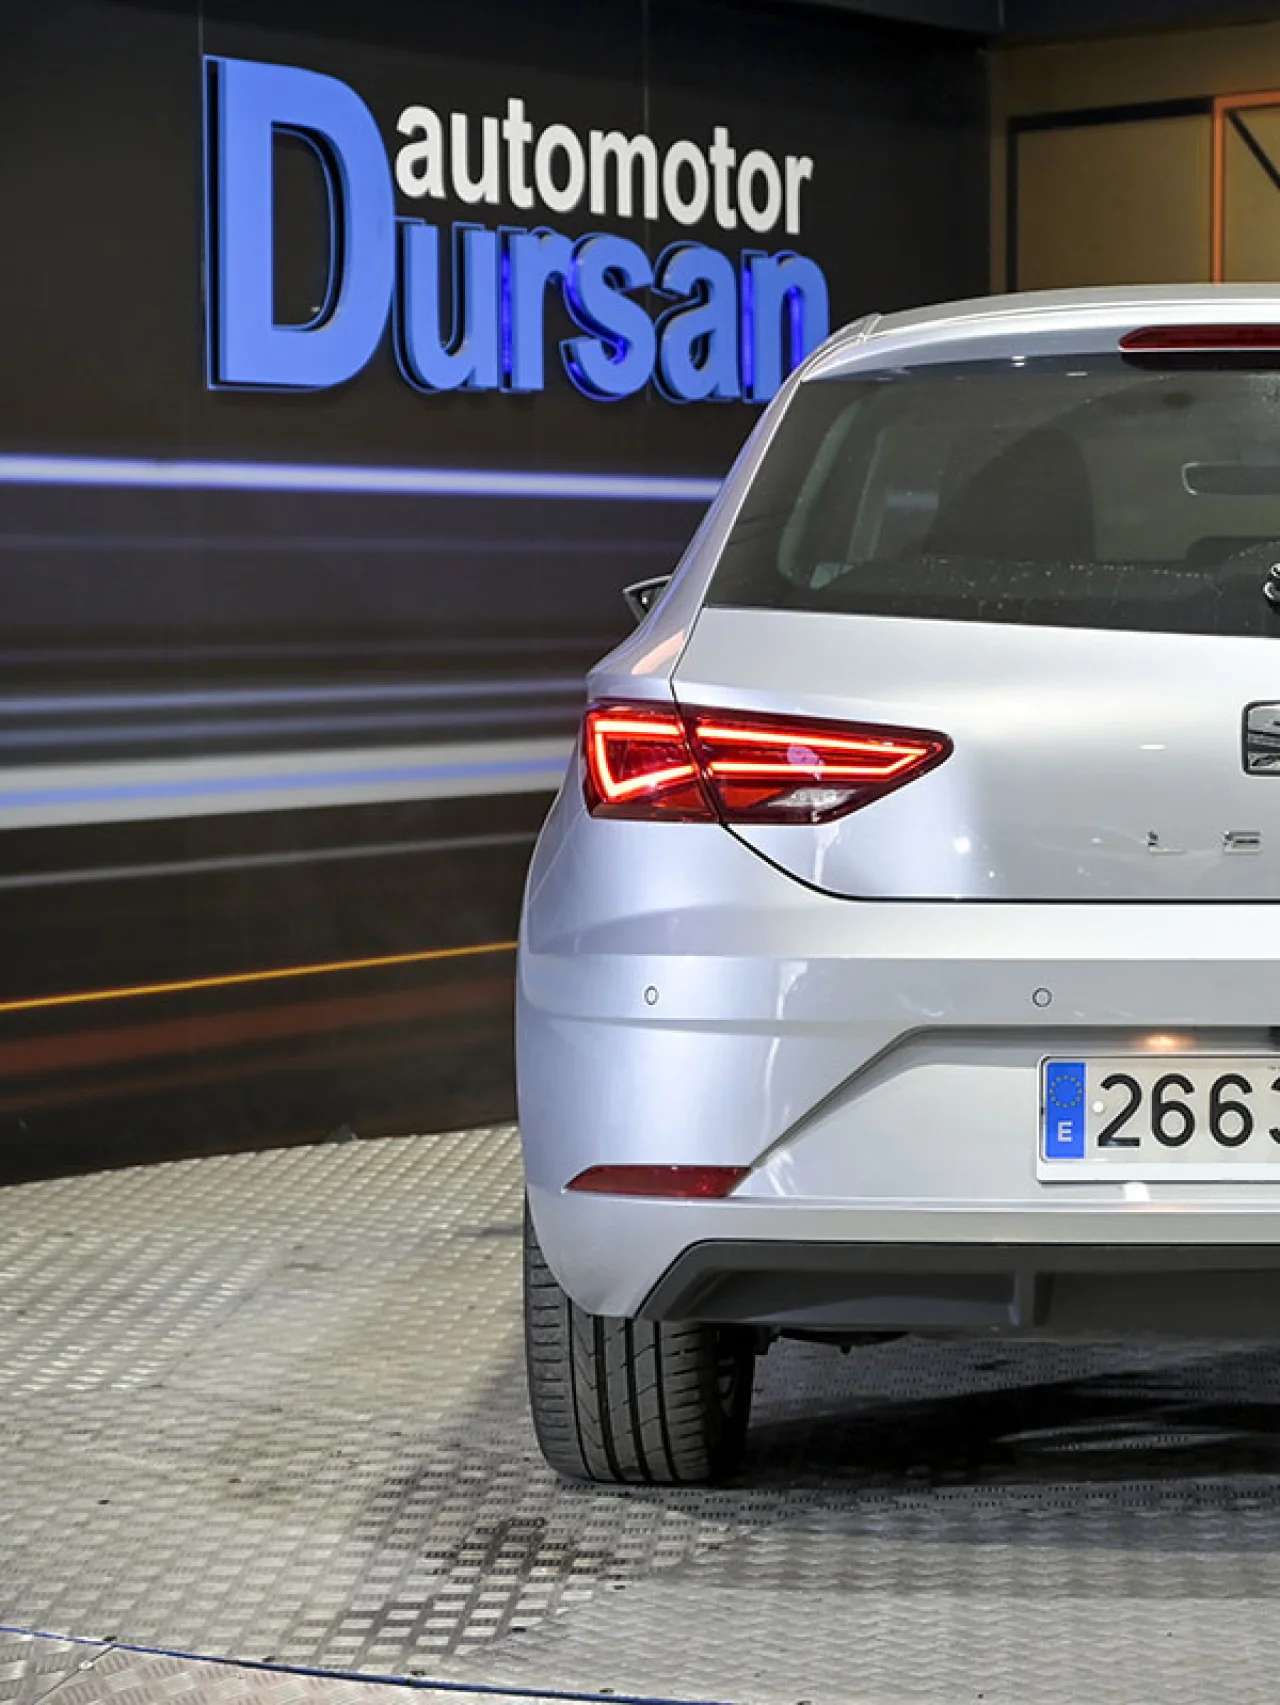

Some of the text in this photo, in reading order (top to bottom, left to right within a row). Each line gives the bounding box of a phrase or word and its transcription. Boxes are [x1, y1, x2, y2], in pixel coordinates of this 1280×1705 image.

[202, 55, 832, 404] Dursan
[396, 97, 813, 235] automotor
[1057, 1120, 1074, 1143] E
